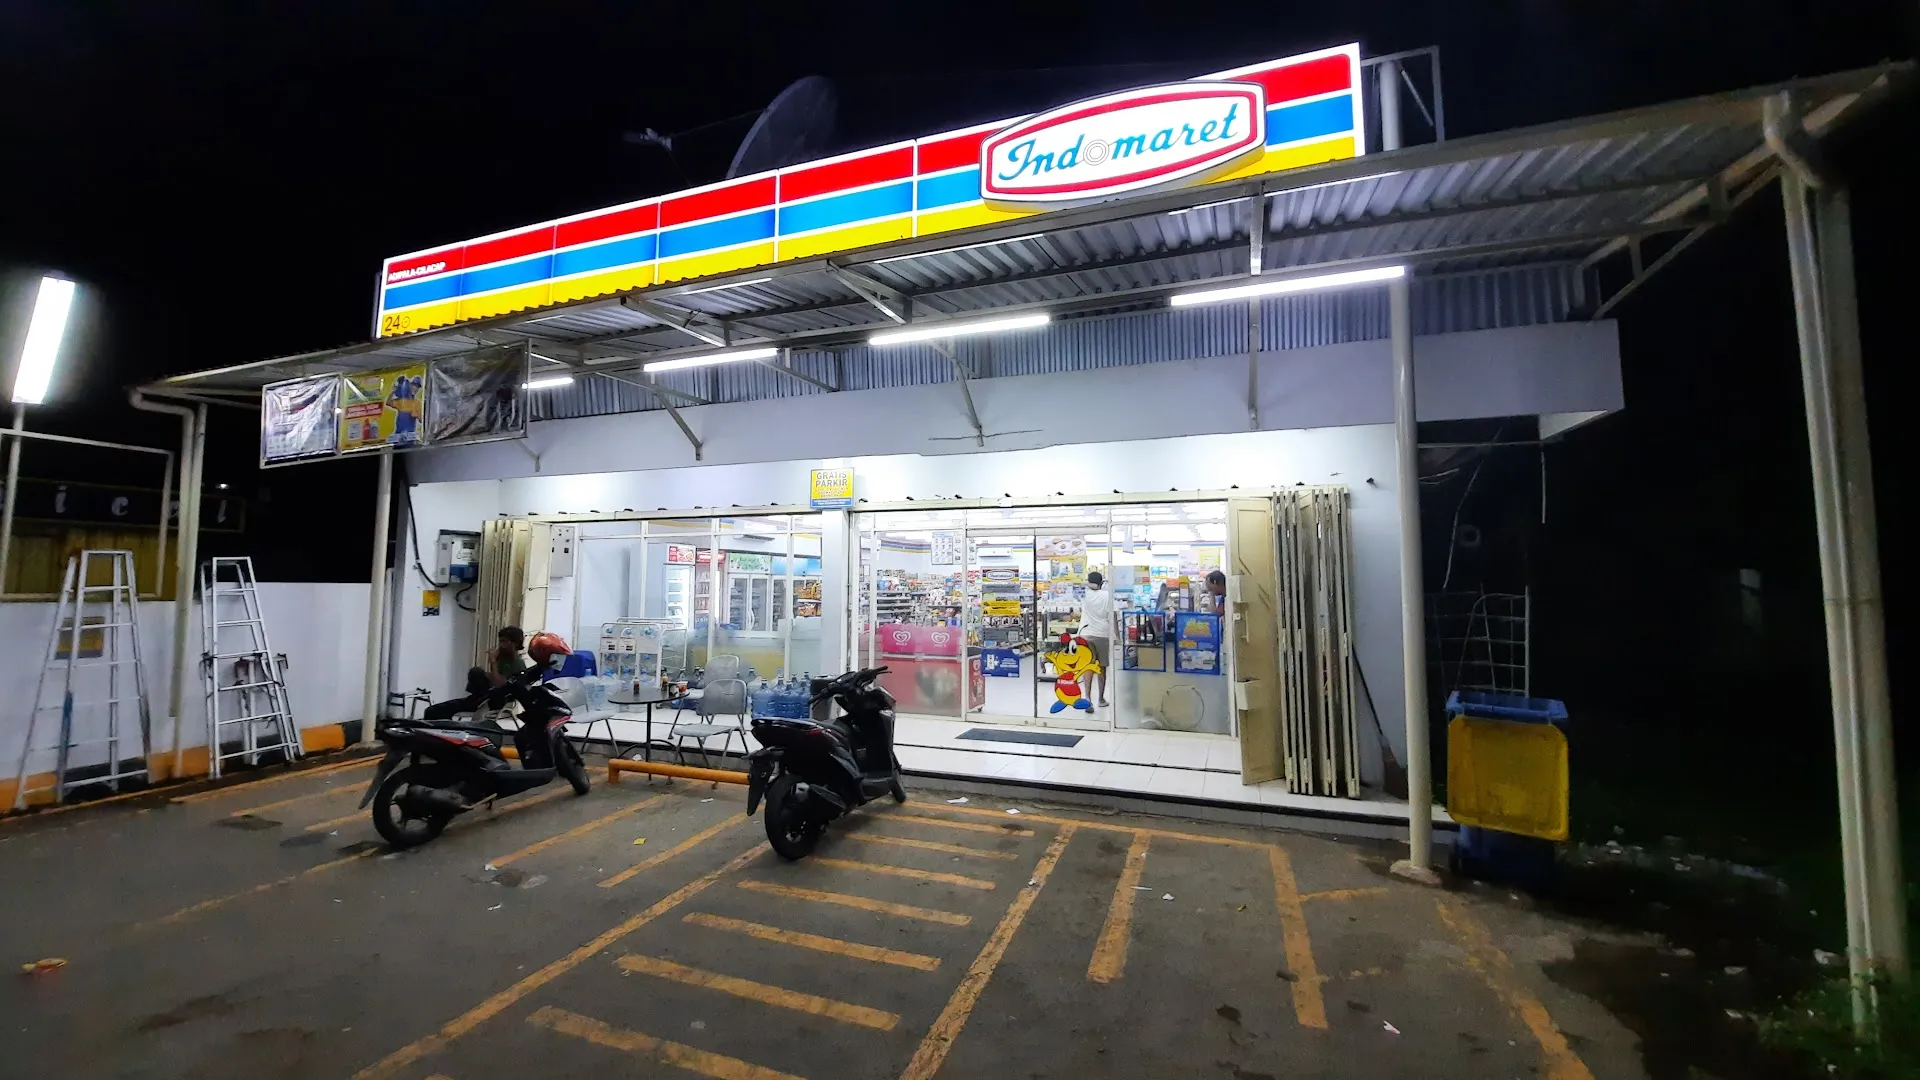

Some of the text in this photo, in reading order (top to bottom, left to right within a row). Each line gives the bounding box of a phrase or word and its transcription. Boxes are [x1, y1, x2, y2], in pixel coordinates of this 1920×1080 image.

[998, 103, 1239, 181] Indomaret
[385, 315, 401, 332] 24
[816, 471, 847, 480] GRATIS
[815, 478, 848, 488] PARKIR
